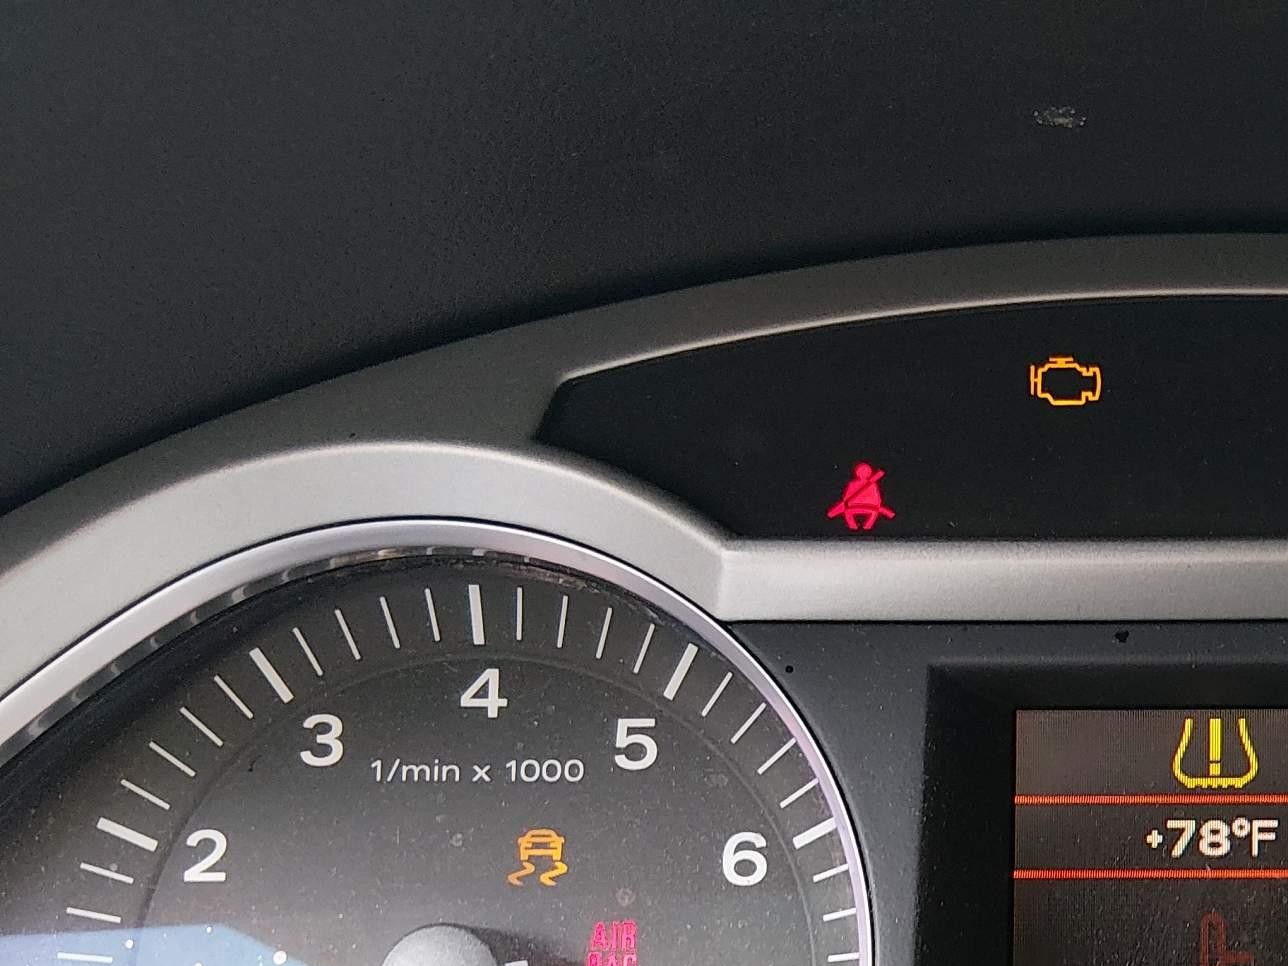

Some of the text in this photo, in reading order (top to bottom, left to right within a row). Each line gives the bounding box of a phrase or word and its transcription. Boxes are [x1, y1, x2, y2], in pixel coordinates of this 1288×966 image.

[461, 669, 507, 717] 4
[301, 715, 342, 766] 3
[615, 719, 657, 770] 5
[371, 759, 583, 782] 1/min x 1000
[184, 830, 226, 882] 2
[723, 832, 767, 886] 6
[591, 920, 637, 951] AIR
